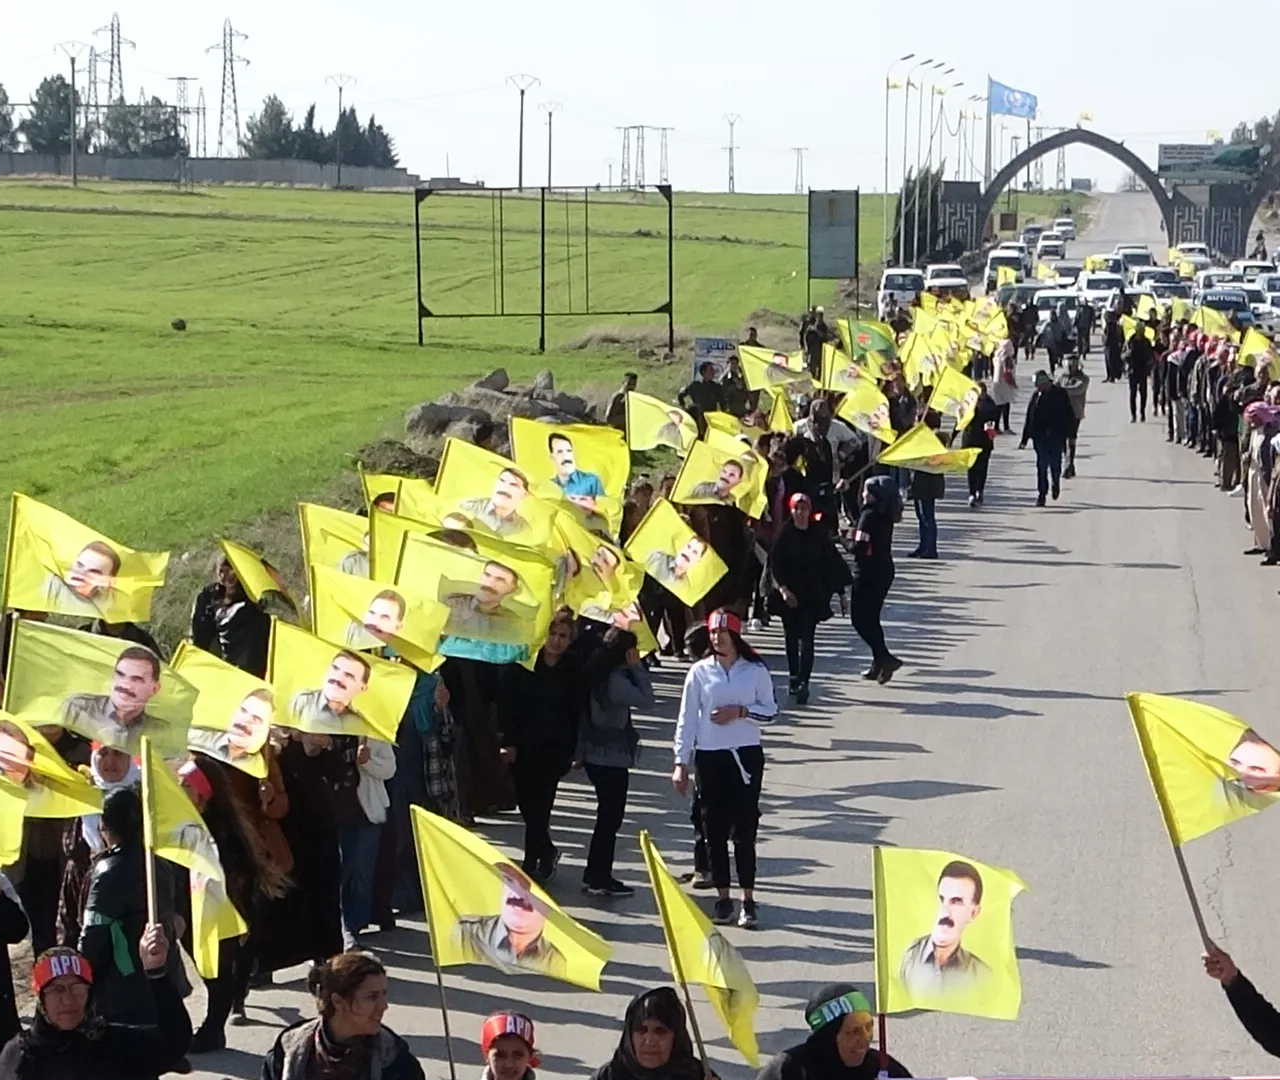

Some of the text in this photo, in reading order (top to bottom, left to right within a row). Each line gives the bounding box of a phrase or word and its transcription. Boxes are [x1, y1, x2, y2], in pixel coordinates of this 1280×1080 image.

[50, 955, 81, 977] APO
[822, 996, 853, 1022] APO
[506, 1015, 532, 1041] APO
